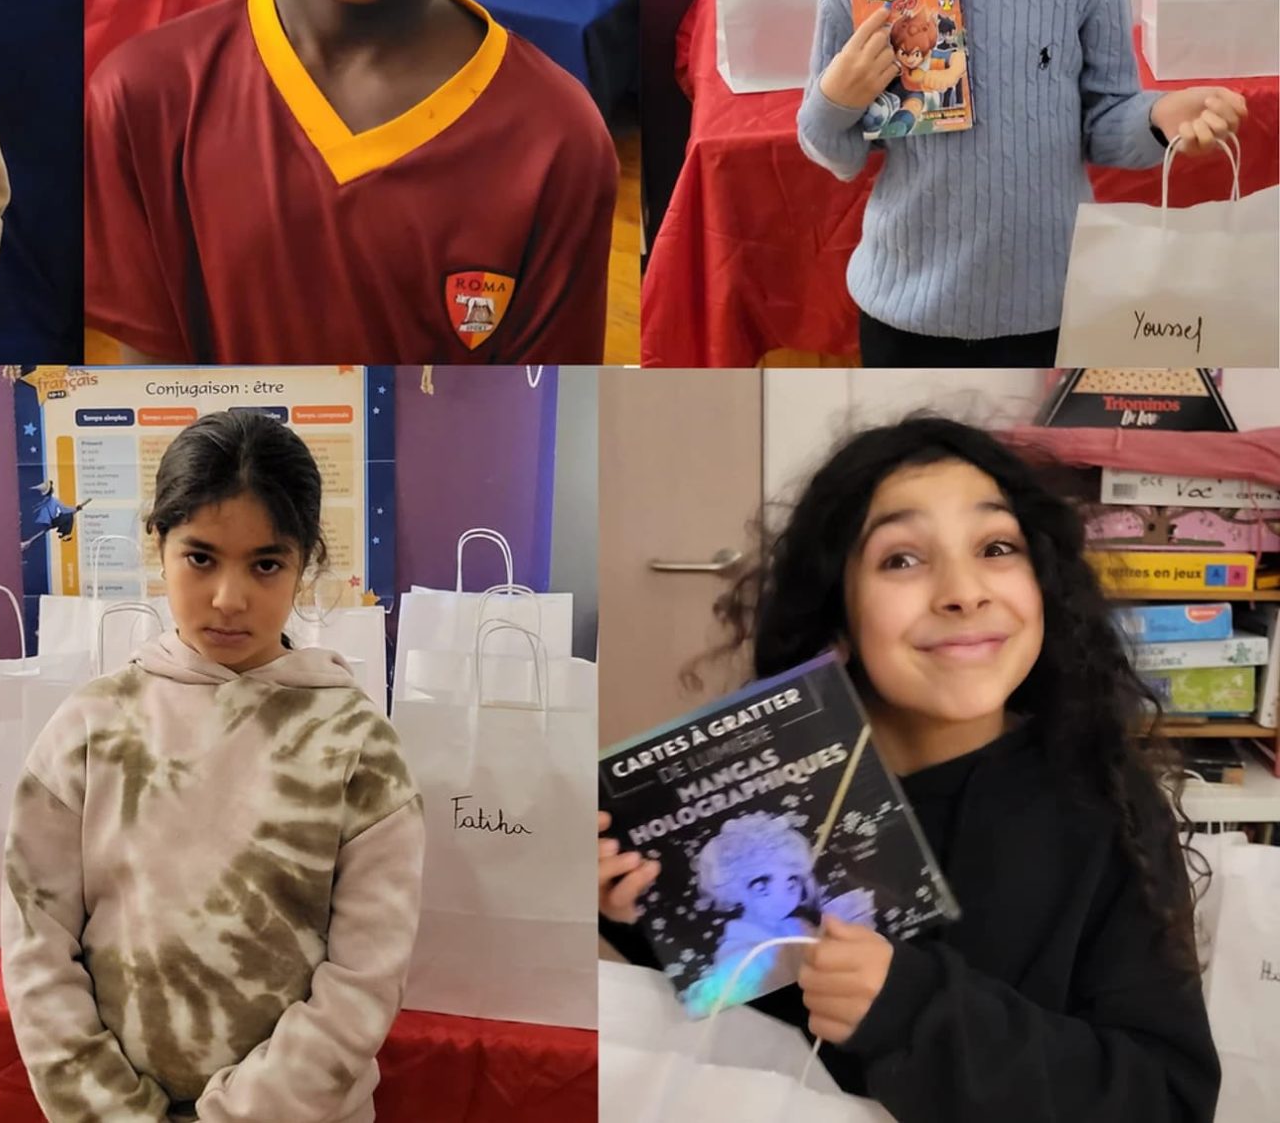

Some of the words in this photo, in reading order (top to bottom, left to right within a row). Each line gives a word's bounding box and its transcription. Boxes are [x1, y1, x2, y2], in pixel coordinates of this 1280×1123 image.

[455, 277, 507, 293] ROMA
[38, 374, 99, 392] français
[145, 381, 240, 398] Conjugaison
[253, 380, 285, 394] être
[1103, 395, 1181, 412] Triominos
[1153, 567, 1171, 579] en
[1173, 566, 1202, 581] jeux
[612, 736, 690, 778] CARTES
[691, 725, 710, 747] À
[706, 688, 802, 739] GRATTER
[658, 762, 687, 785] DE
[675, 748, 781, 804] MANGAS
[628, 742, 850, 846] HOLOGRAPHIQUES
[450, 795, 533, 835] Fatiha
